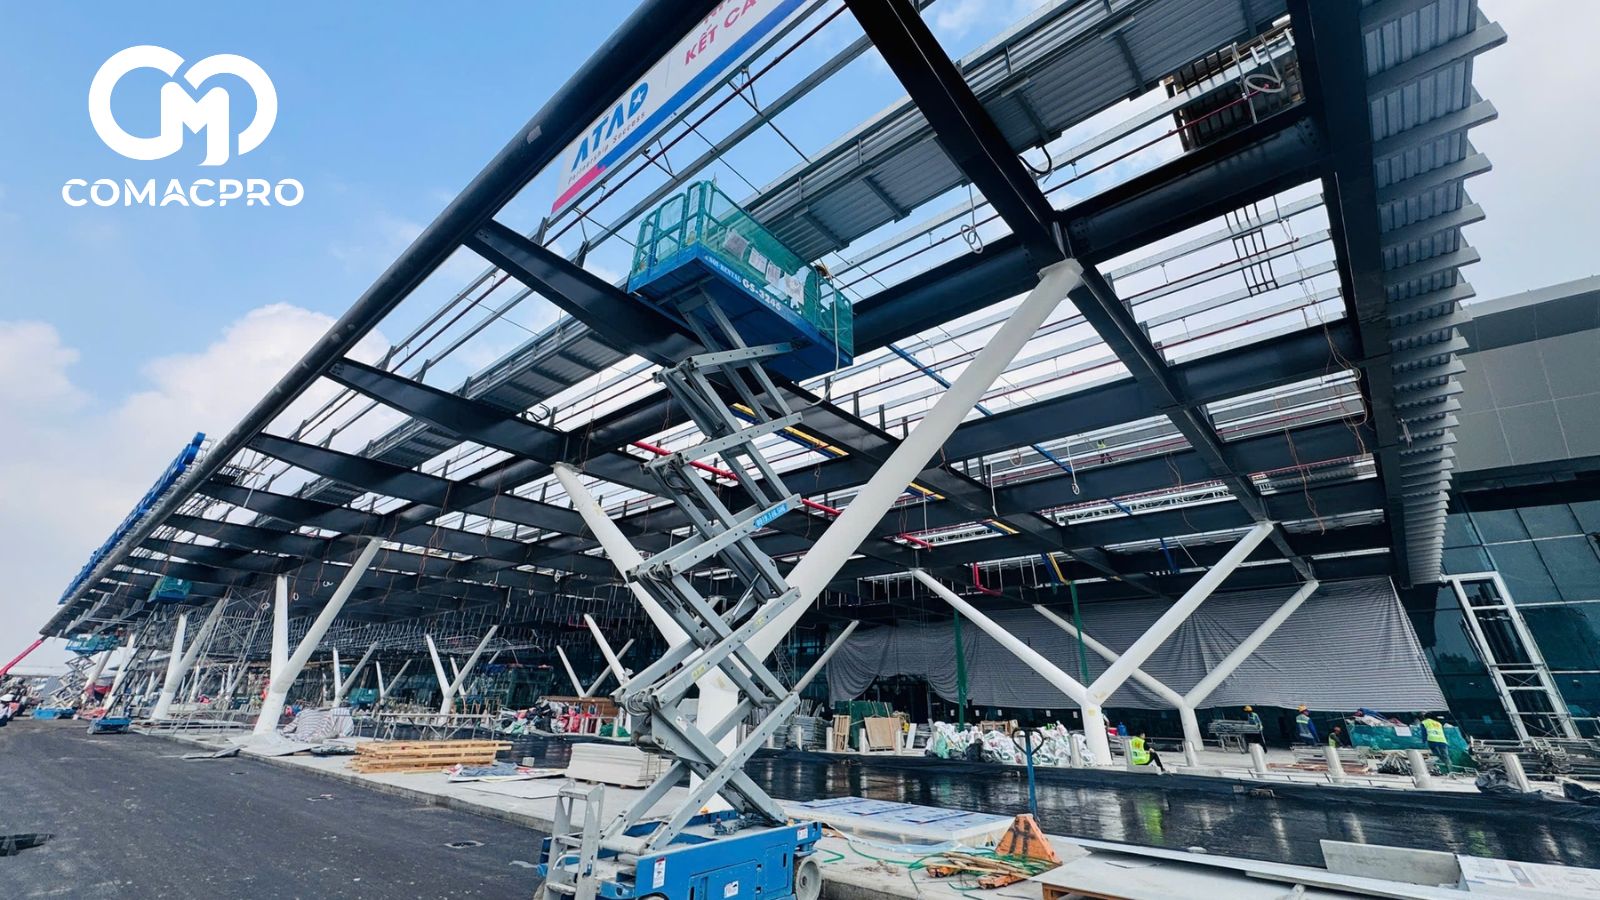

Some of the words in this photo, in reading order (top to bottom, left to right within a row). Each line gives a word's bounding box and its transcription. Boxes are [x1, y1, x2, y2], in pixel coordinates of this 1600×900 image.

[685, 23, 718, 65] KẾT
[571, 82, 649, 172] ATAD
[612, 111, 646, 144] Success
